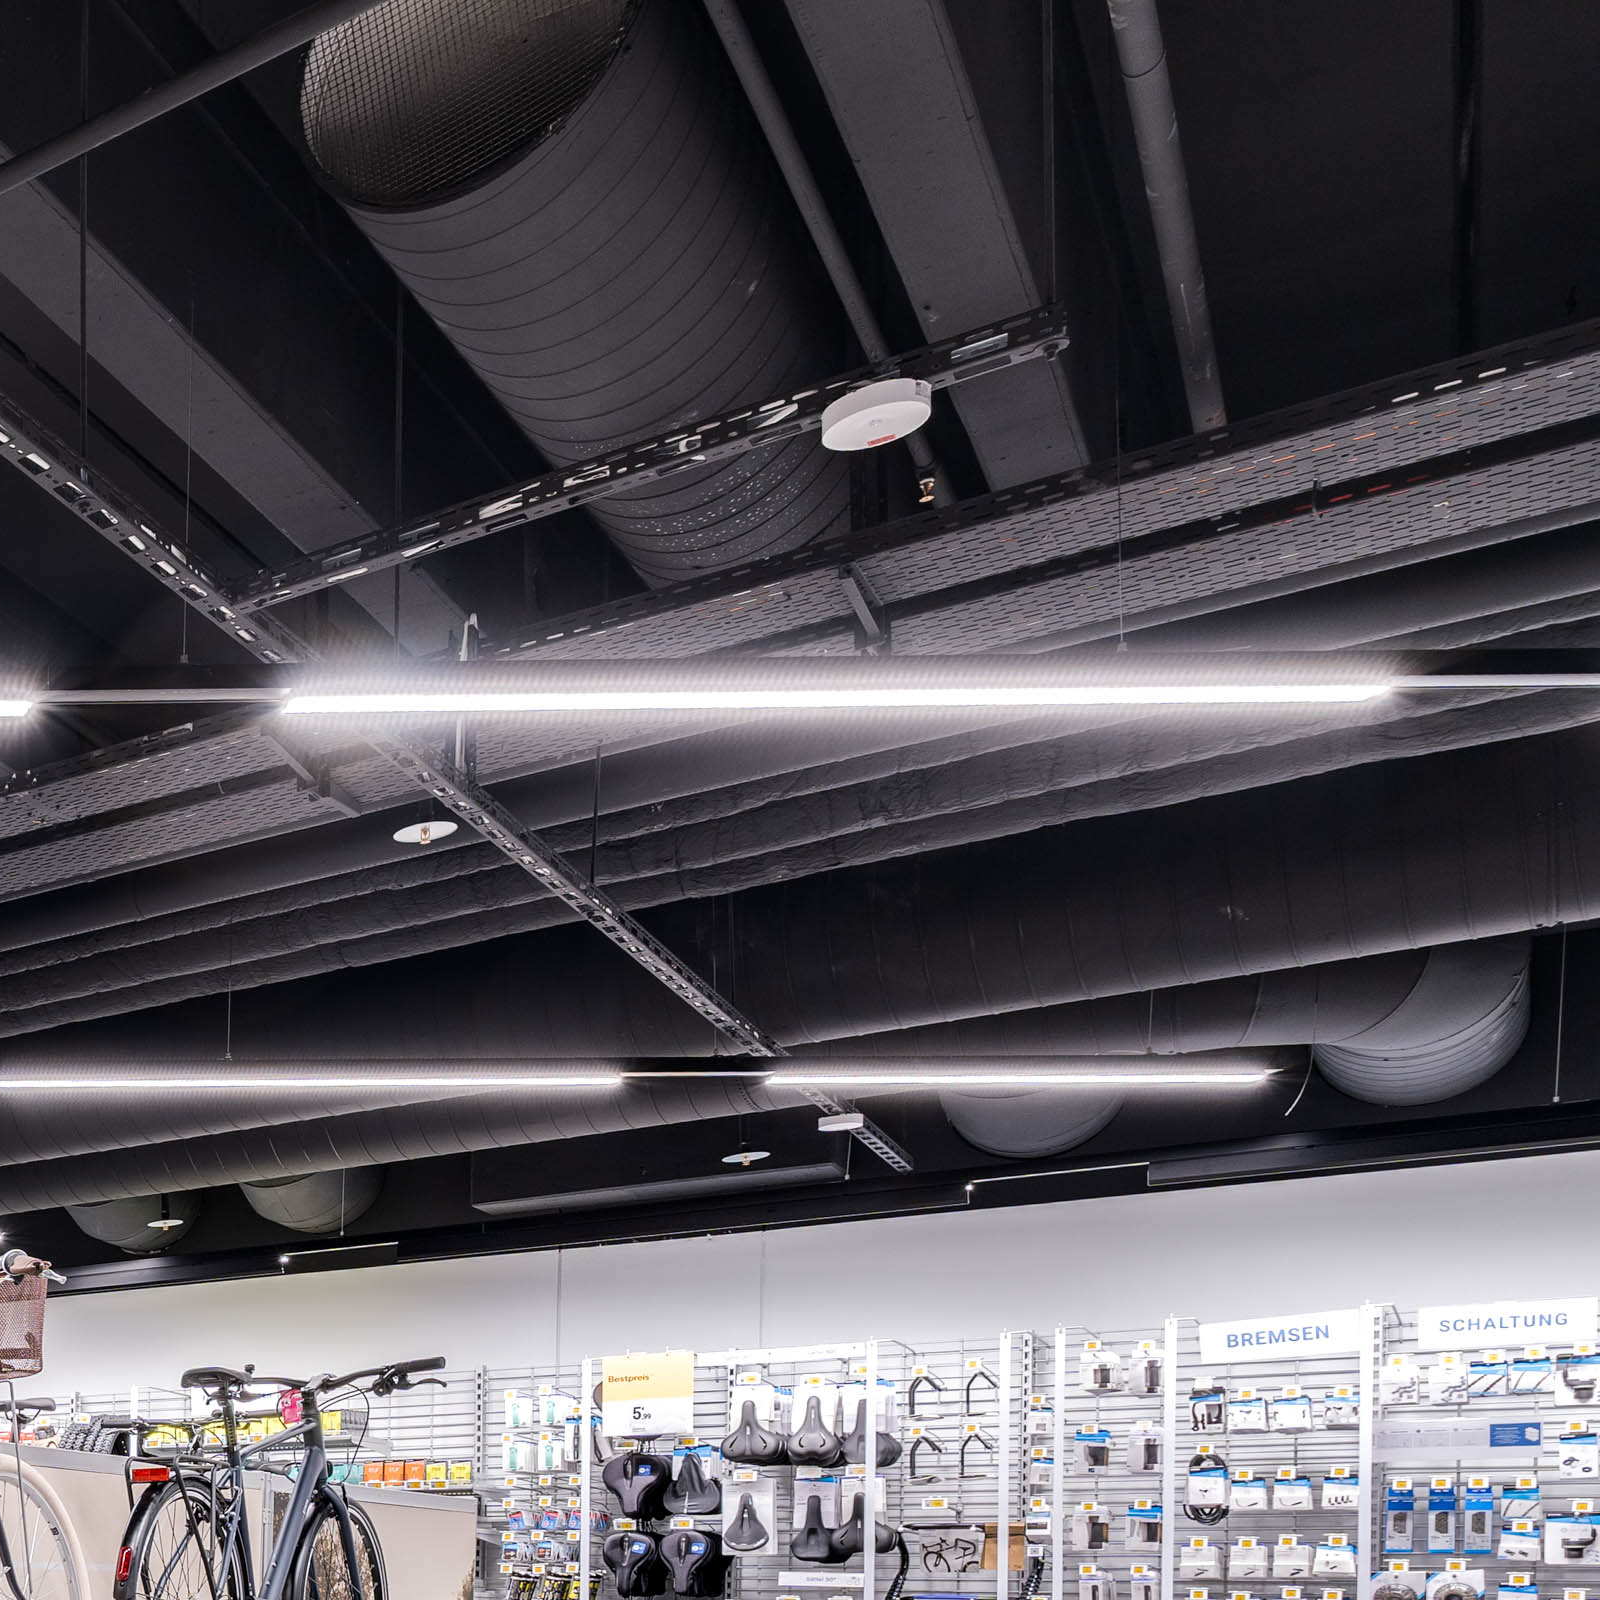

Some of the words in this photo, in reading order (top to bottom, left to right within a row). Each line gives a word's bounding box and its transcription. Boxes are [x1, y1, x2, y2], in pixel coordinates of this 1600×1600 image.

[1439, 1313, 1568, 1333] SCHALTUNG
[1226, 1325, 1329, 1348] BREMSEN
[608, 1374, 650, 1383] Bestpreis
